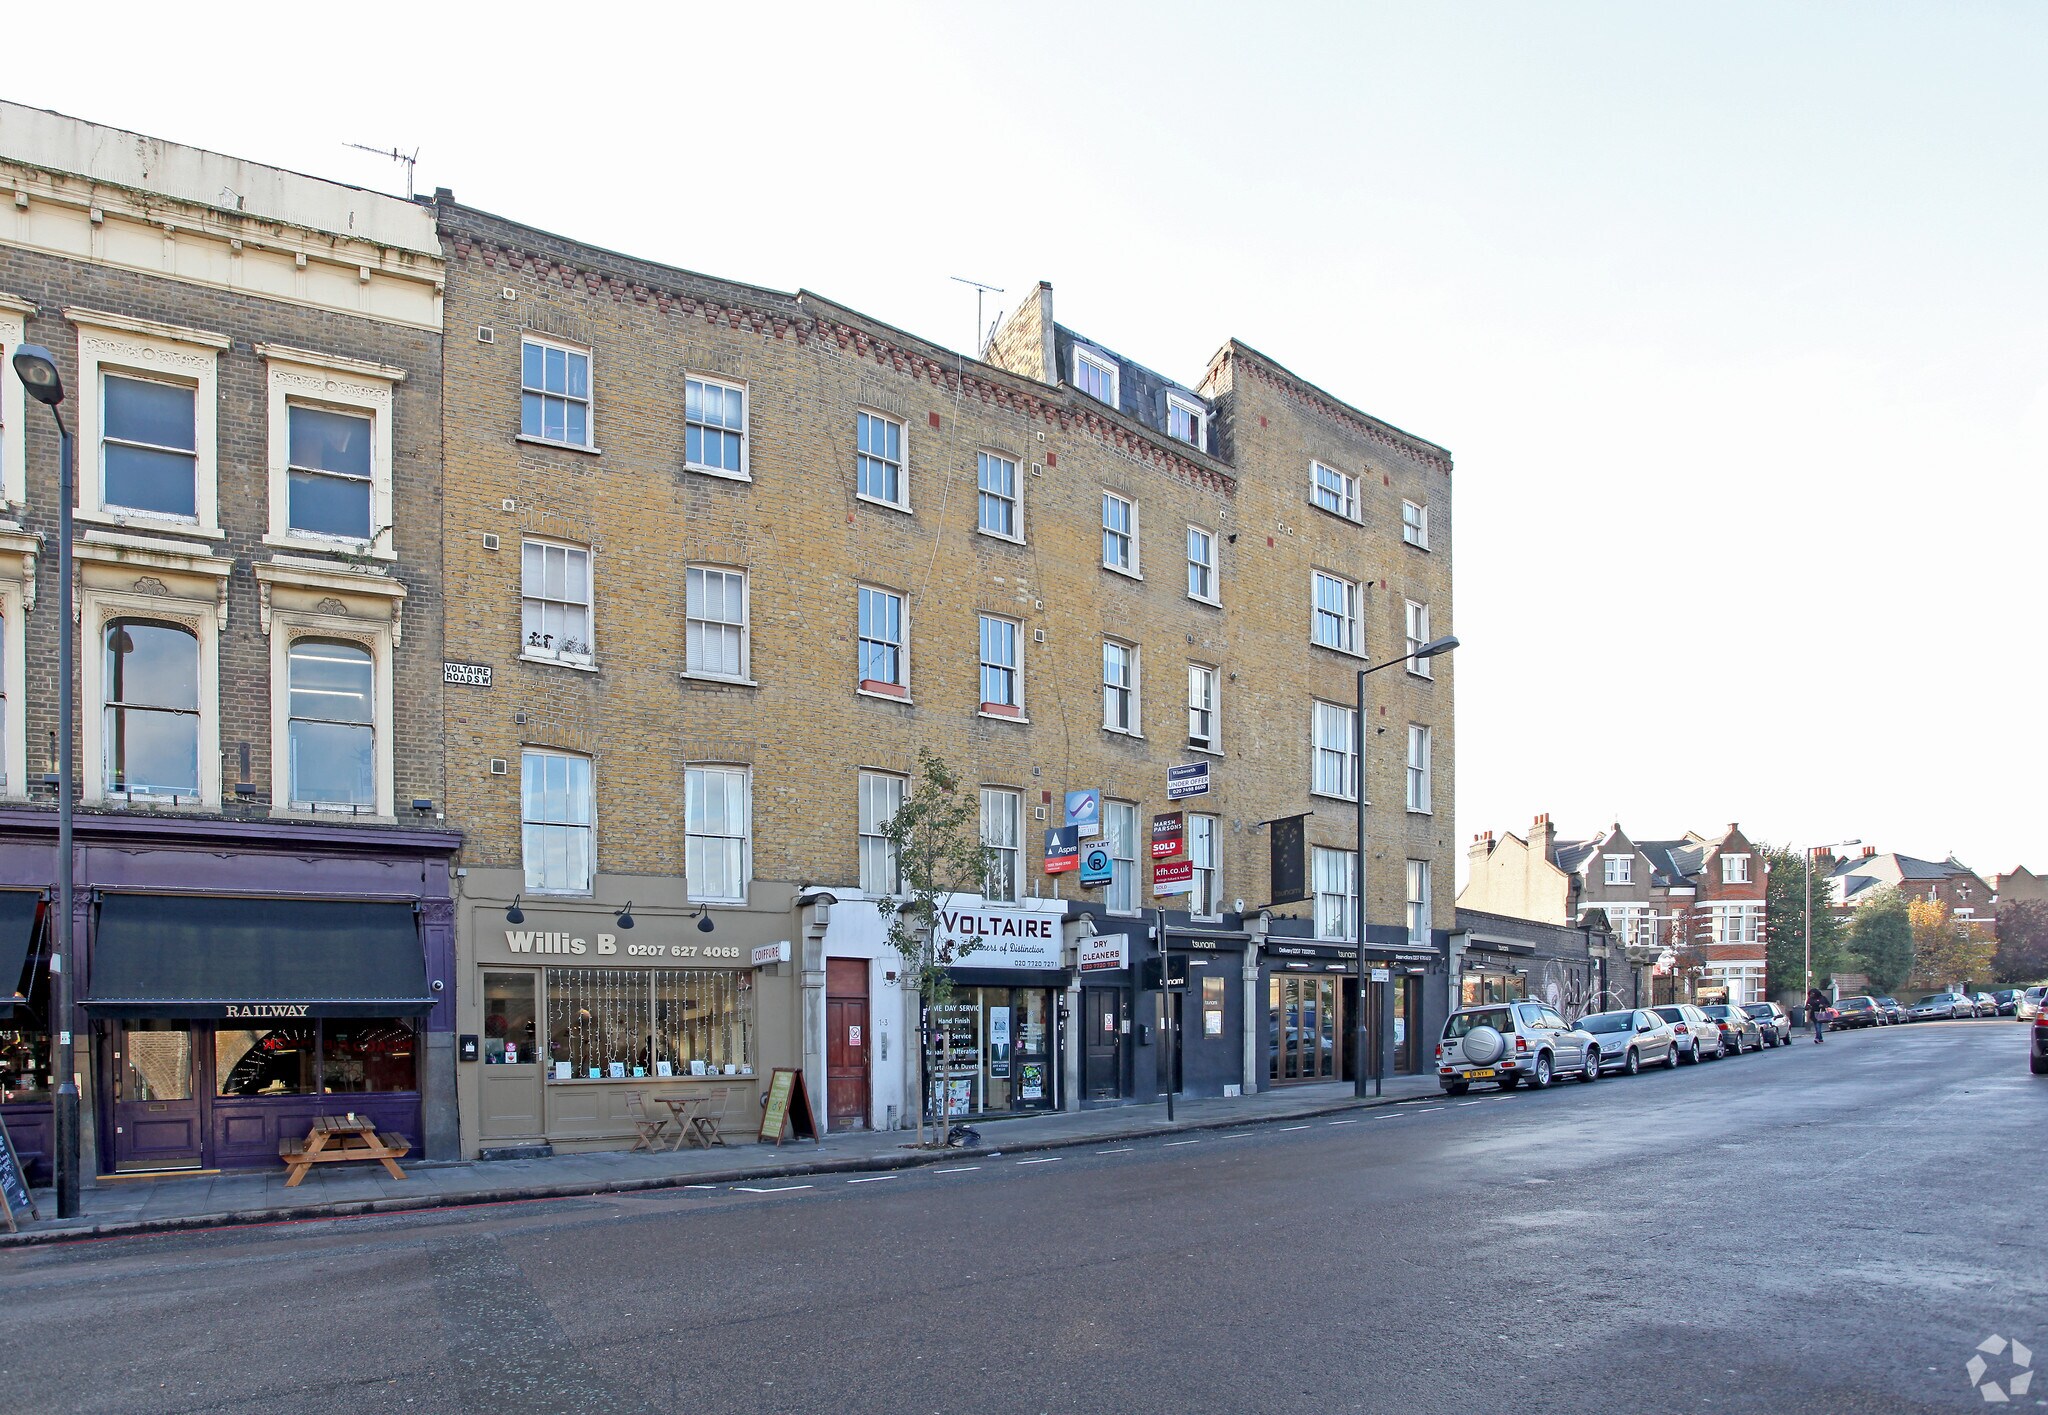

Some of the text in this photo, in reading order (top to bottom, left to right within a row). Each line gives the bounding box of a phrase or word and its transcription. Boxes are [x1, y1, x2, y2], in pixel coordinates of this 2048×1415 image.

[445, 664, 489, 676] VOLTAIRE
[1168, 777, 1208, 788] UNDER OFFER
[1153, 819, 1176, 828] MARSH
[1153, 823, 1182, 833] PARSONS
[1153, 842, 1176, 851] SOLD
[1155, 865, 1190, 877] kfh.co.uk
[941, 911, 1052, 938] VOLTAIRE
[504, 931, 617, 955] Willis B
[999, 942, 1008, 955] of
[1010, 942, 1045, 954] Distinction
[1093, 940, 1108, 948] DRY
[1191, 940, 1216, 949] tsunami
[627, 944, 740, 958] 0207 627 4068
[755, 946, 779, 961] COIFFURE
[1082, 950, 1120, 961] CLEANERS
[1337, 950, 1357, 958] tsunami
[1159, 976, 1184, 986] tnami
[225, 1005, 310, 1018] RAILWAY
[944, 1004, 957, 1012] DAY
[959, 1004, 979, 1012] SERVIC
[951, 1032, 971, 1040] Service
